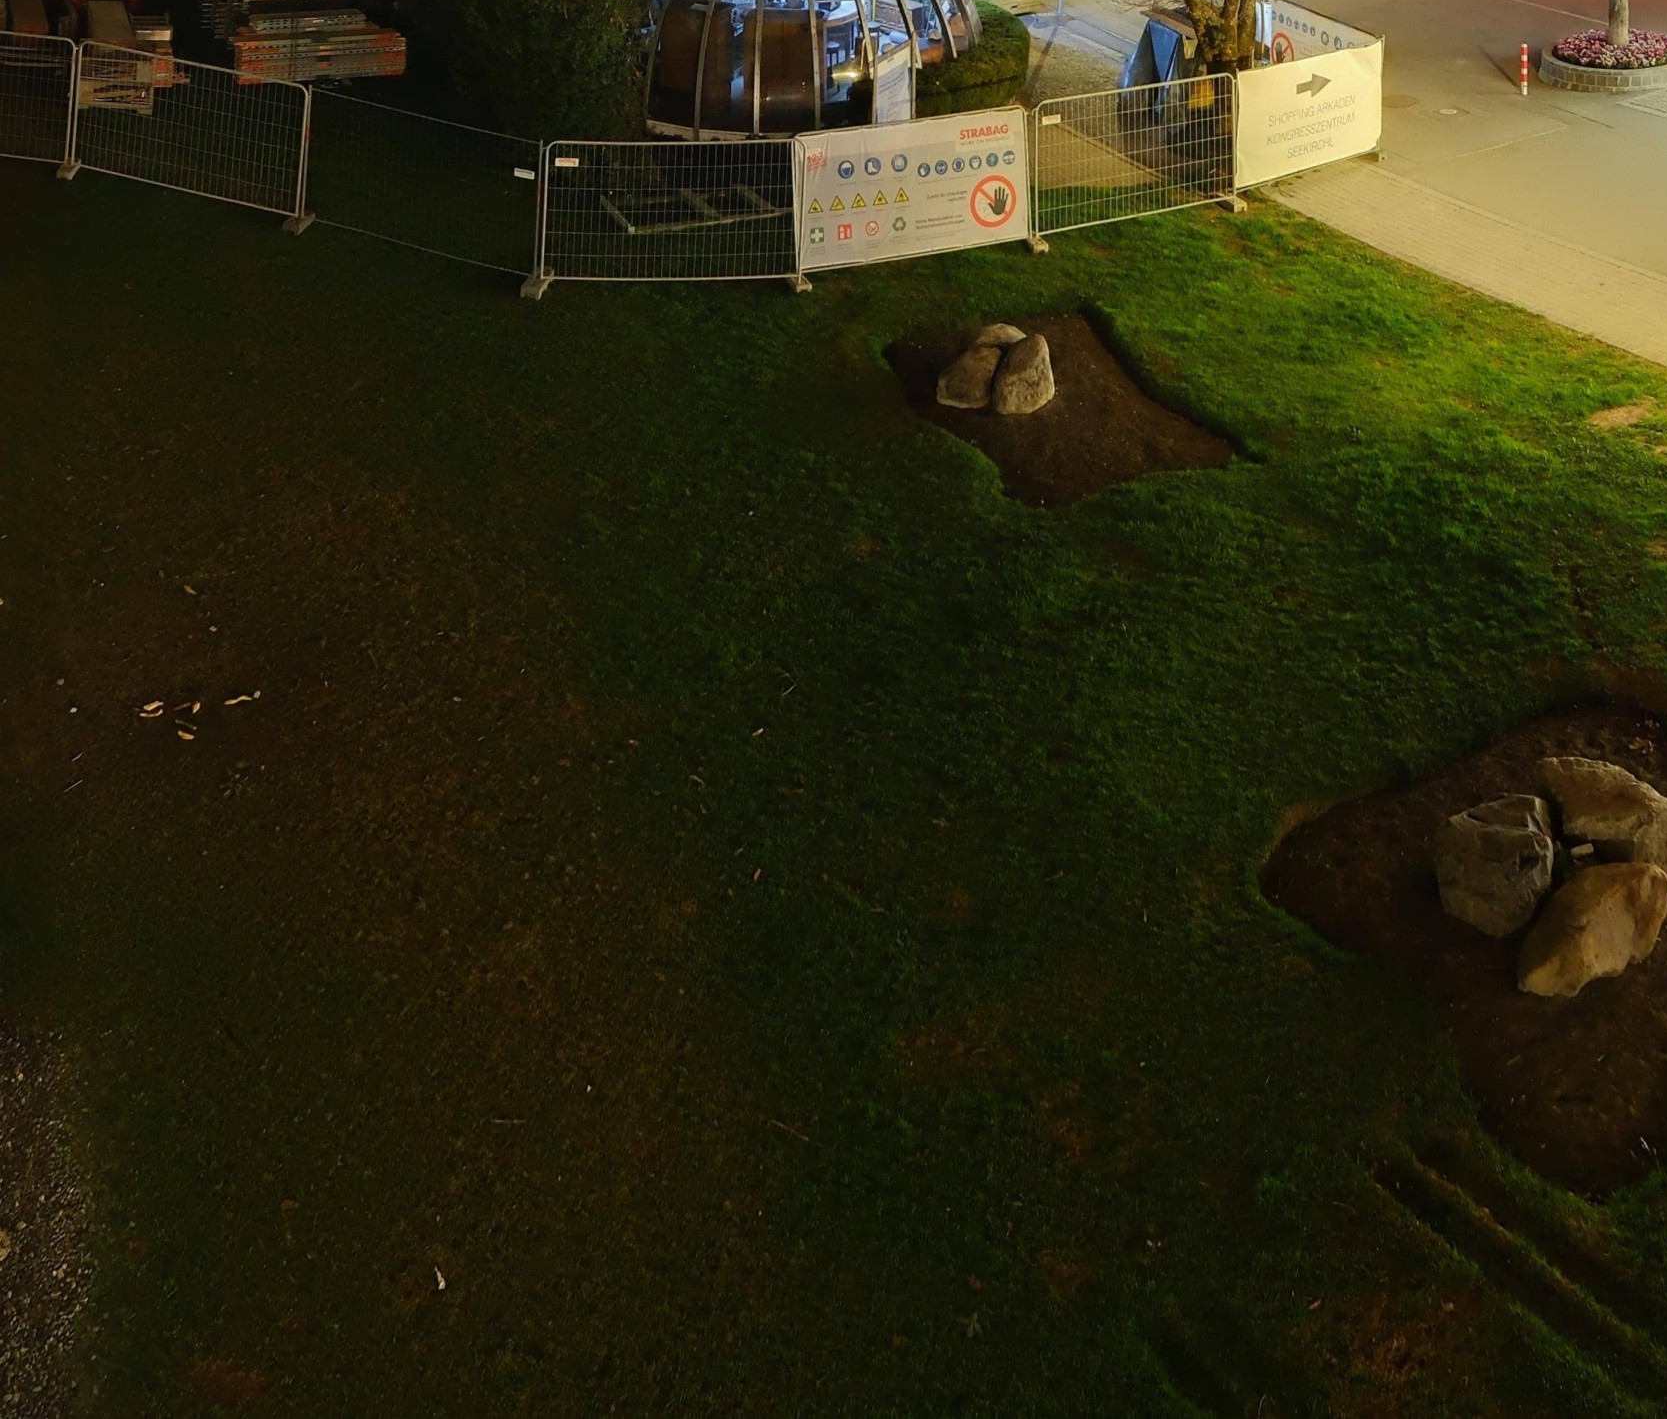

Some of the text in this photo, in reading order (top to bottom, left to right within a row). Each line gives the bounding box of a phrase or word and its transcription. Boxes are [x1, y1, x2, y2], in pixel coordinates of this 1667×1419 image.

[1268, 95, 1356, 127] SHOPPING ARKADEN
[959, 124, 1009, 140] STRABAG
[1266, 112, 1355, 146] KONGRESSZENTRUM
[1287, 137, 1334, 159] SEEKIRCHL
